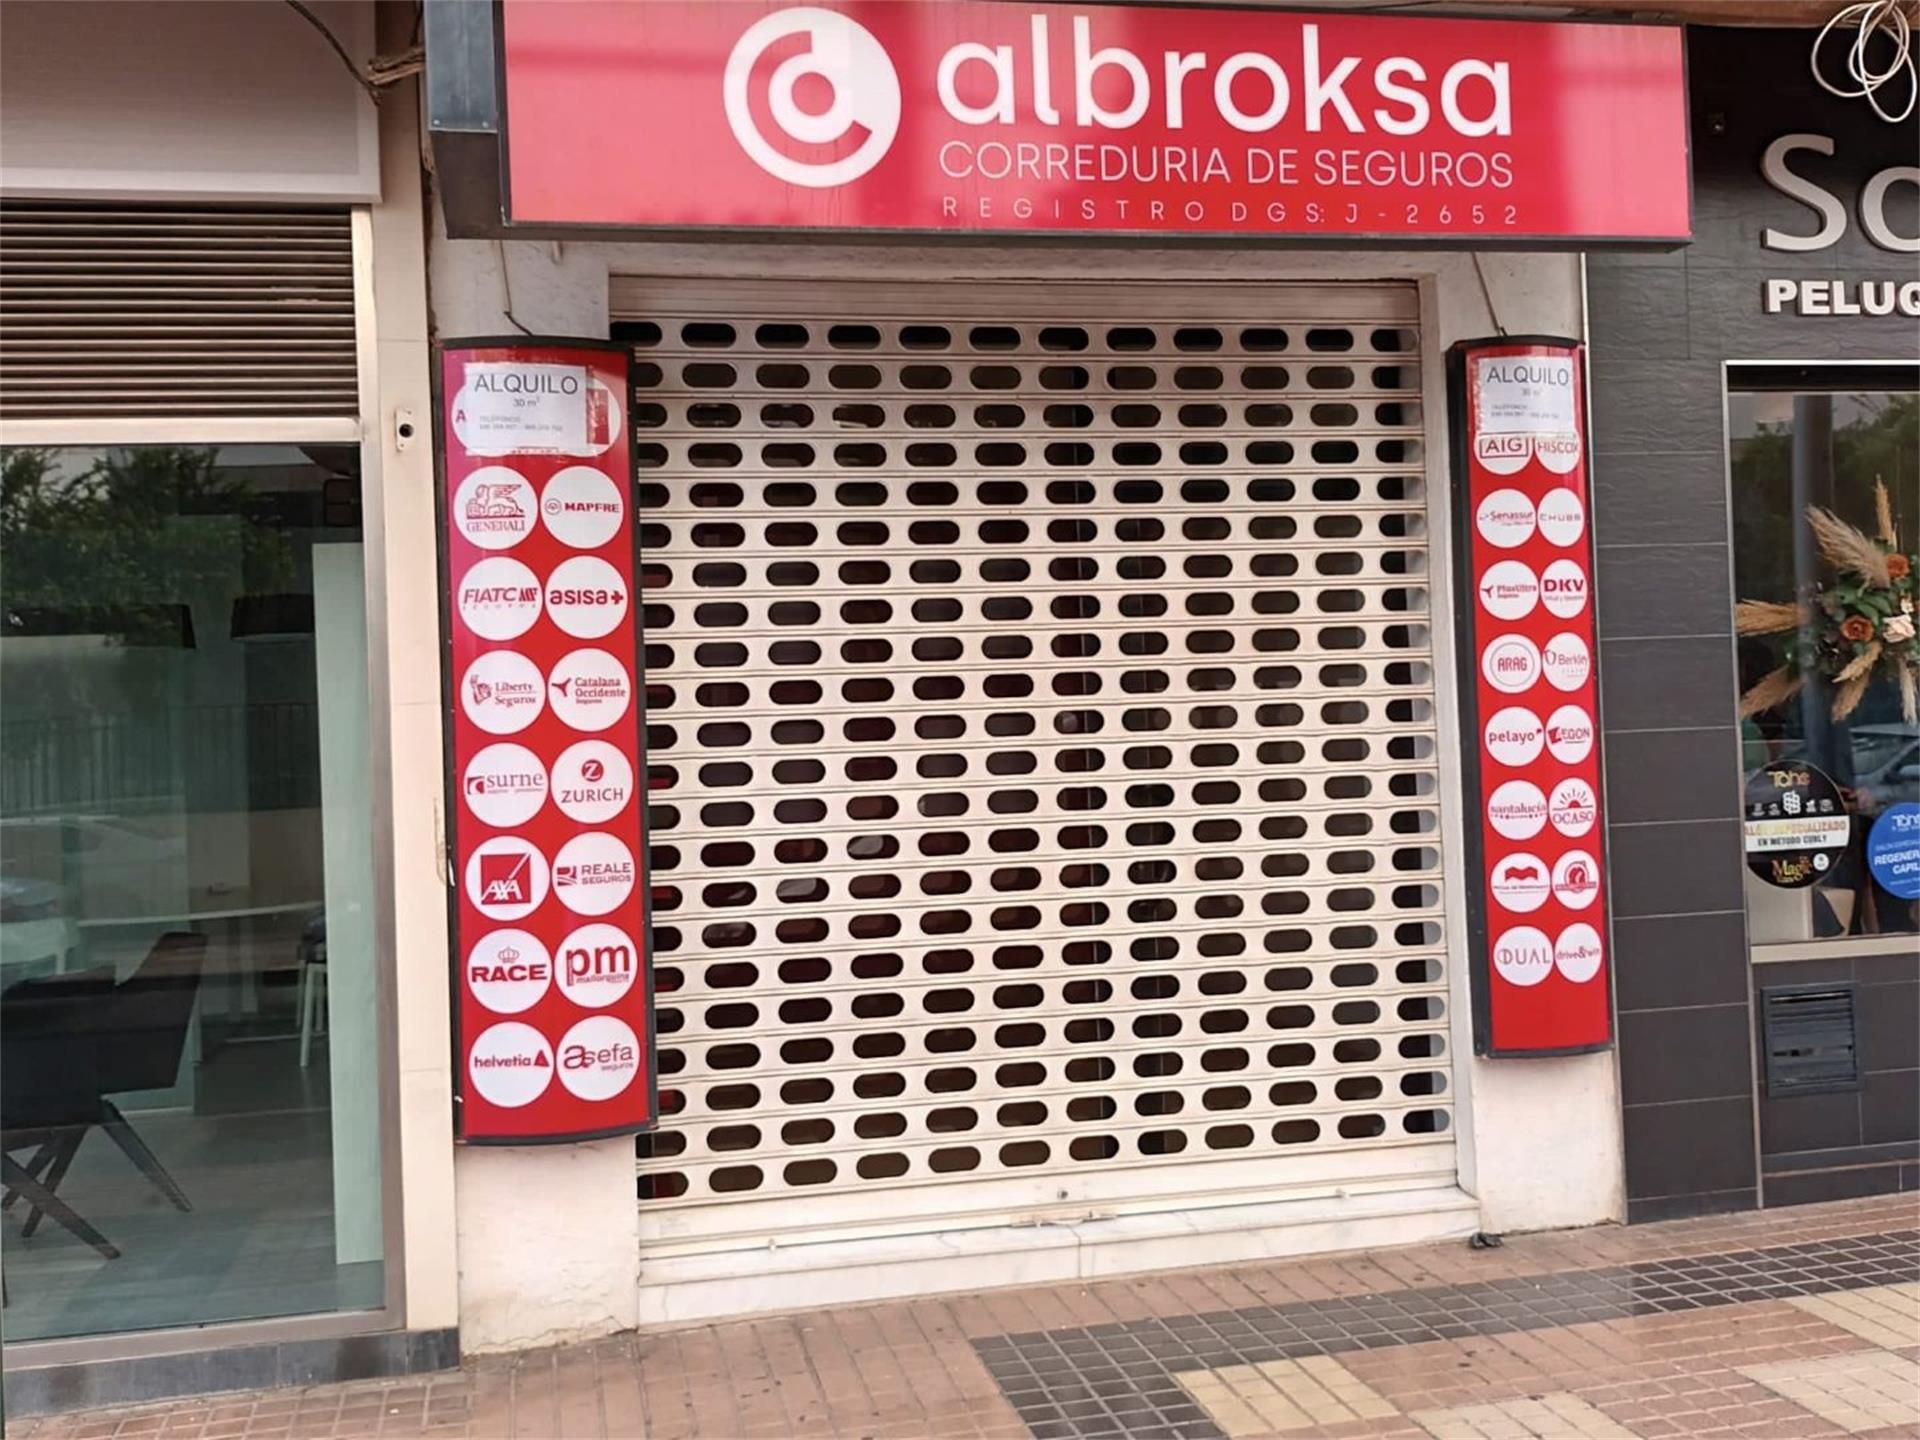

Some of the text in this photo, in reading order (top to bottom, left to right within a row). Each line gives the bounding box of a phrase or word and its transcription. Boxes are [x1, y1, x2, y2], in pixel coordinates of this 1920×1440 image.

[937, 13, 1512, 137] albroksa
[939, 138, 1514, 189] CORREDURIA DE SEGUROS
[1486, 365, 1569, 387] ALQUILO
[474, 373, 578, 395] ALQUILO
[512, 398, 526, 408] 30
[1485, 437, 1523, 454] AIG
[564, 503, 620, 513] MAPFRE
[1539, 513, 1581, 522] CHUBB
[466, 520, 525, 533] GENERALI
[1543, 579, 1585, 593] DKV
[463, 586, 517, 604] FIATC
[550, 589, 608, 605] asisa
[1497, 657, 1528, 672] ARAG
[494, 681, 534, 693] Liberty
[574, 676, 621, 687] Catalana
[574, 687, 626, 698] Occidente
[494, 694, 537, 708] Seguros
[1488, 730, 1535, 746] pelayo
[486, 772, 544, 788] surne
[561, 788, 624, 803] ZURICH
[1552, 811, 1594, 825] OCASO
[581, 862, 631, 875] REALE
[581, 874, 632, 885] SEGUROS
[480, 879, 523, 901] AXA
[565, 944, 631, 987] pm
[471, 964, 548, 983] RACE
[474, 1053, 532, 1068] helvetia
[563, 1043, 634, 1070] asefa
